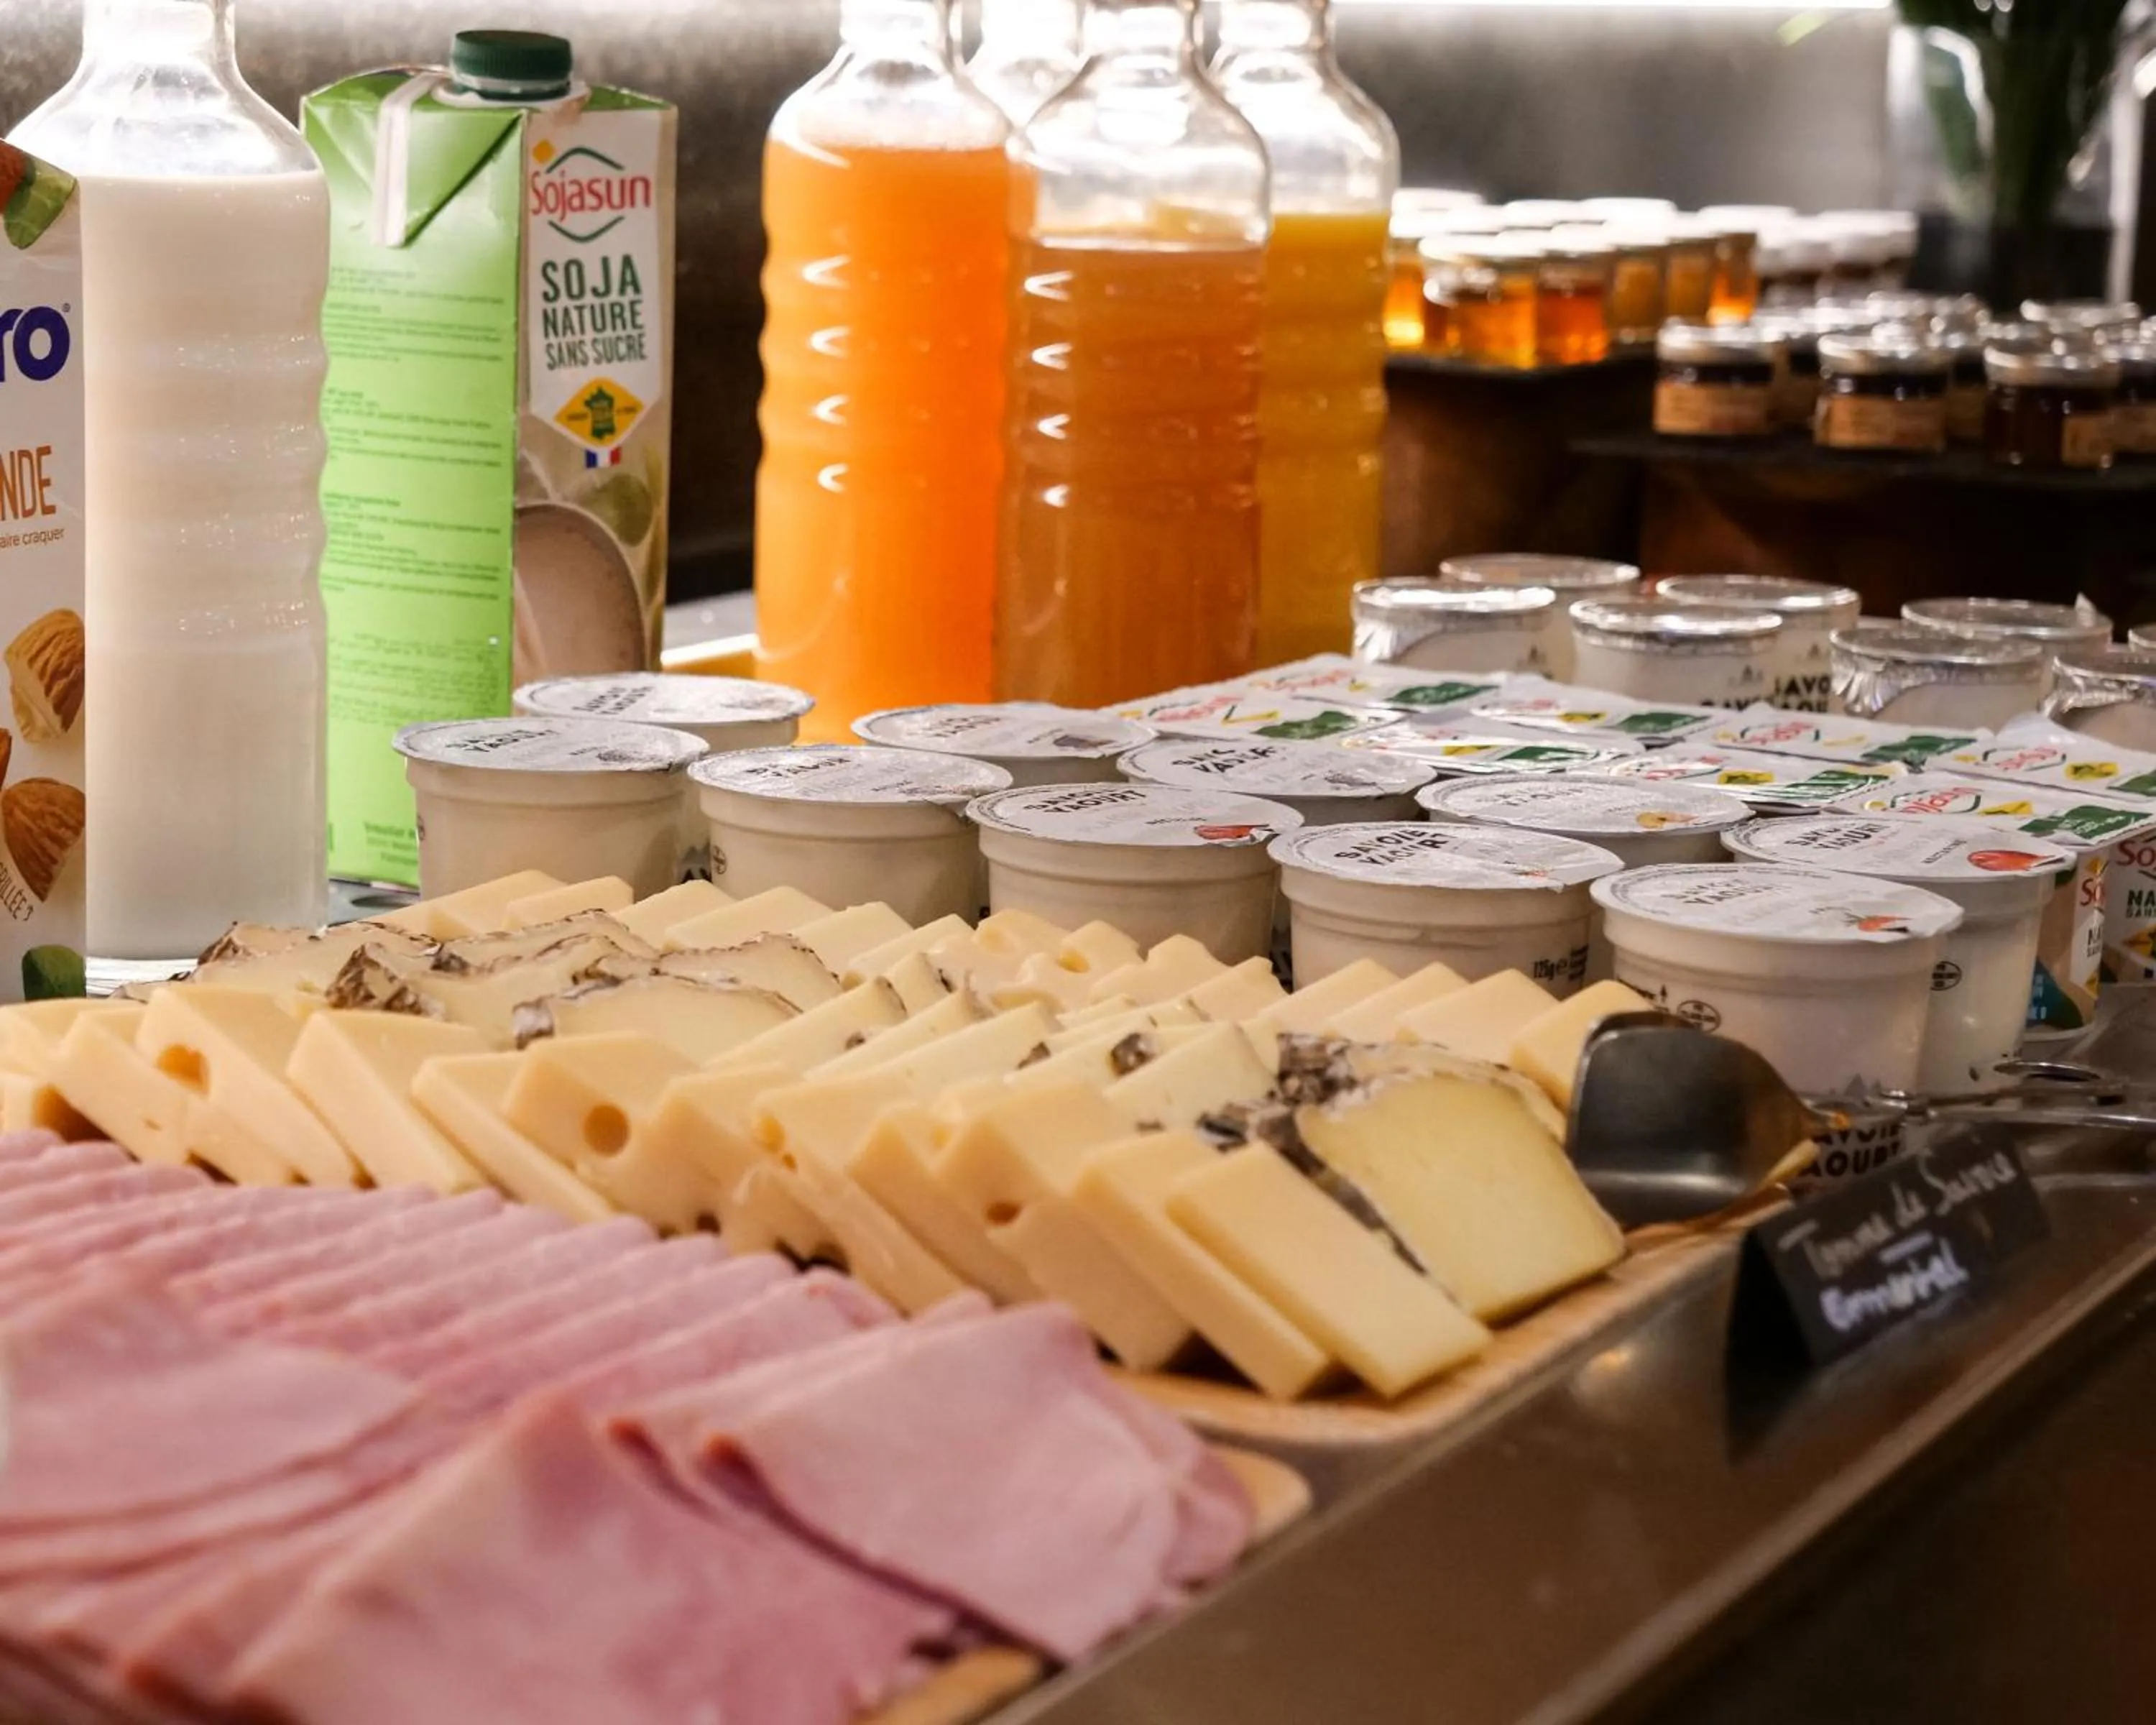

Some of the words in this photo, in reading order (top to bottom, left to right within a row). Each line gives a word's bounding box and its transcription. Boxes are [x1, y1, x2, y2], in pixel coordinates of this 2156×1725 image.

[531, 170, 651, 222] Sojasun
[541, 254, 642, 303] SOJA
[543, 299, 644, 339] NATURE
[545, 339, 590, 371] SANS
[591, 333, 648, 365] SUCRE
[0, 445, 56, 522] NDE
[22, 528, 65, 546] craquer
[1774, 673, 1831, 696] AVO
[2116, 839, 2156, 872] So
